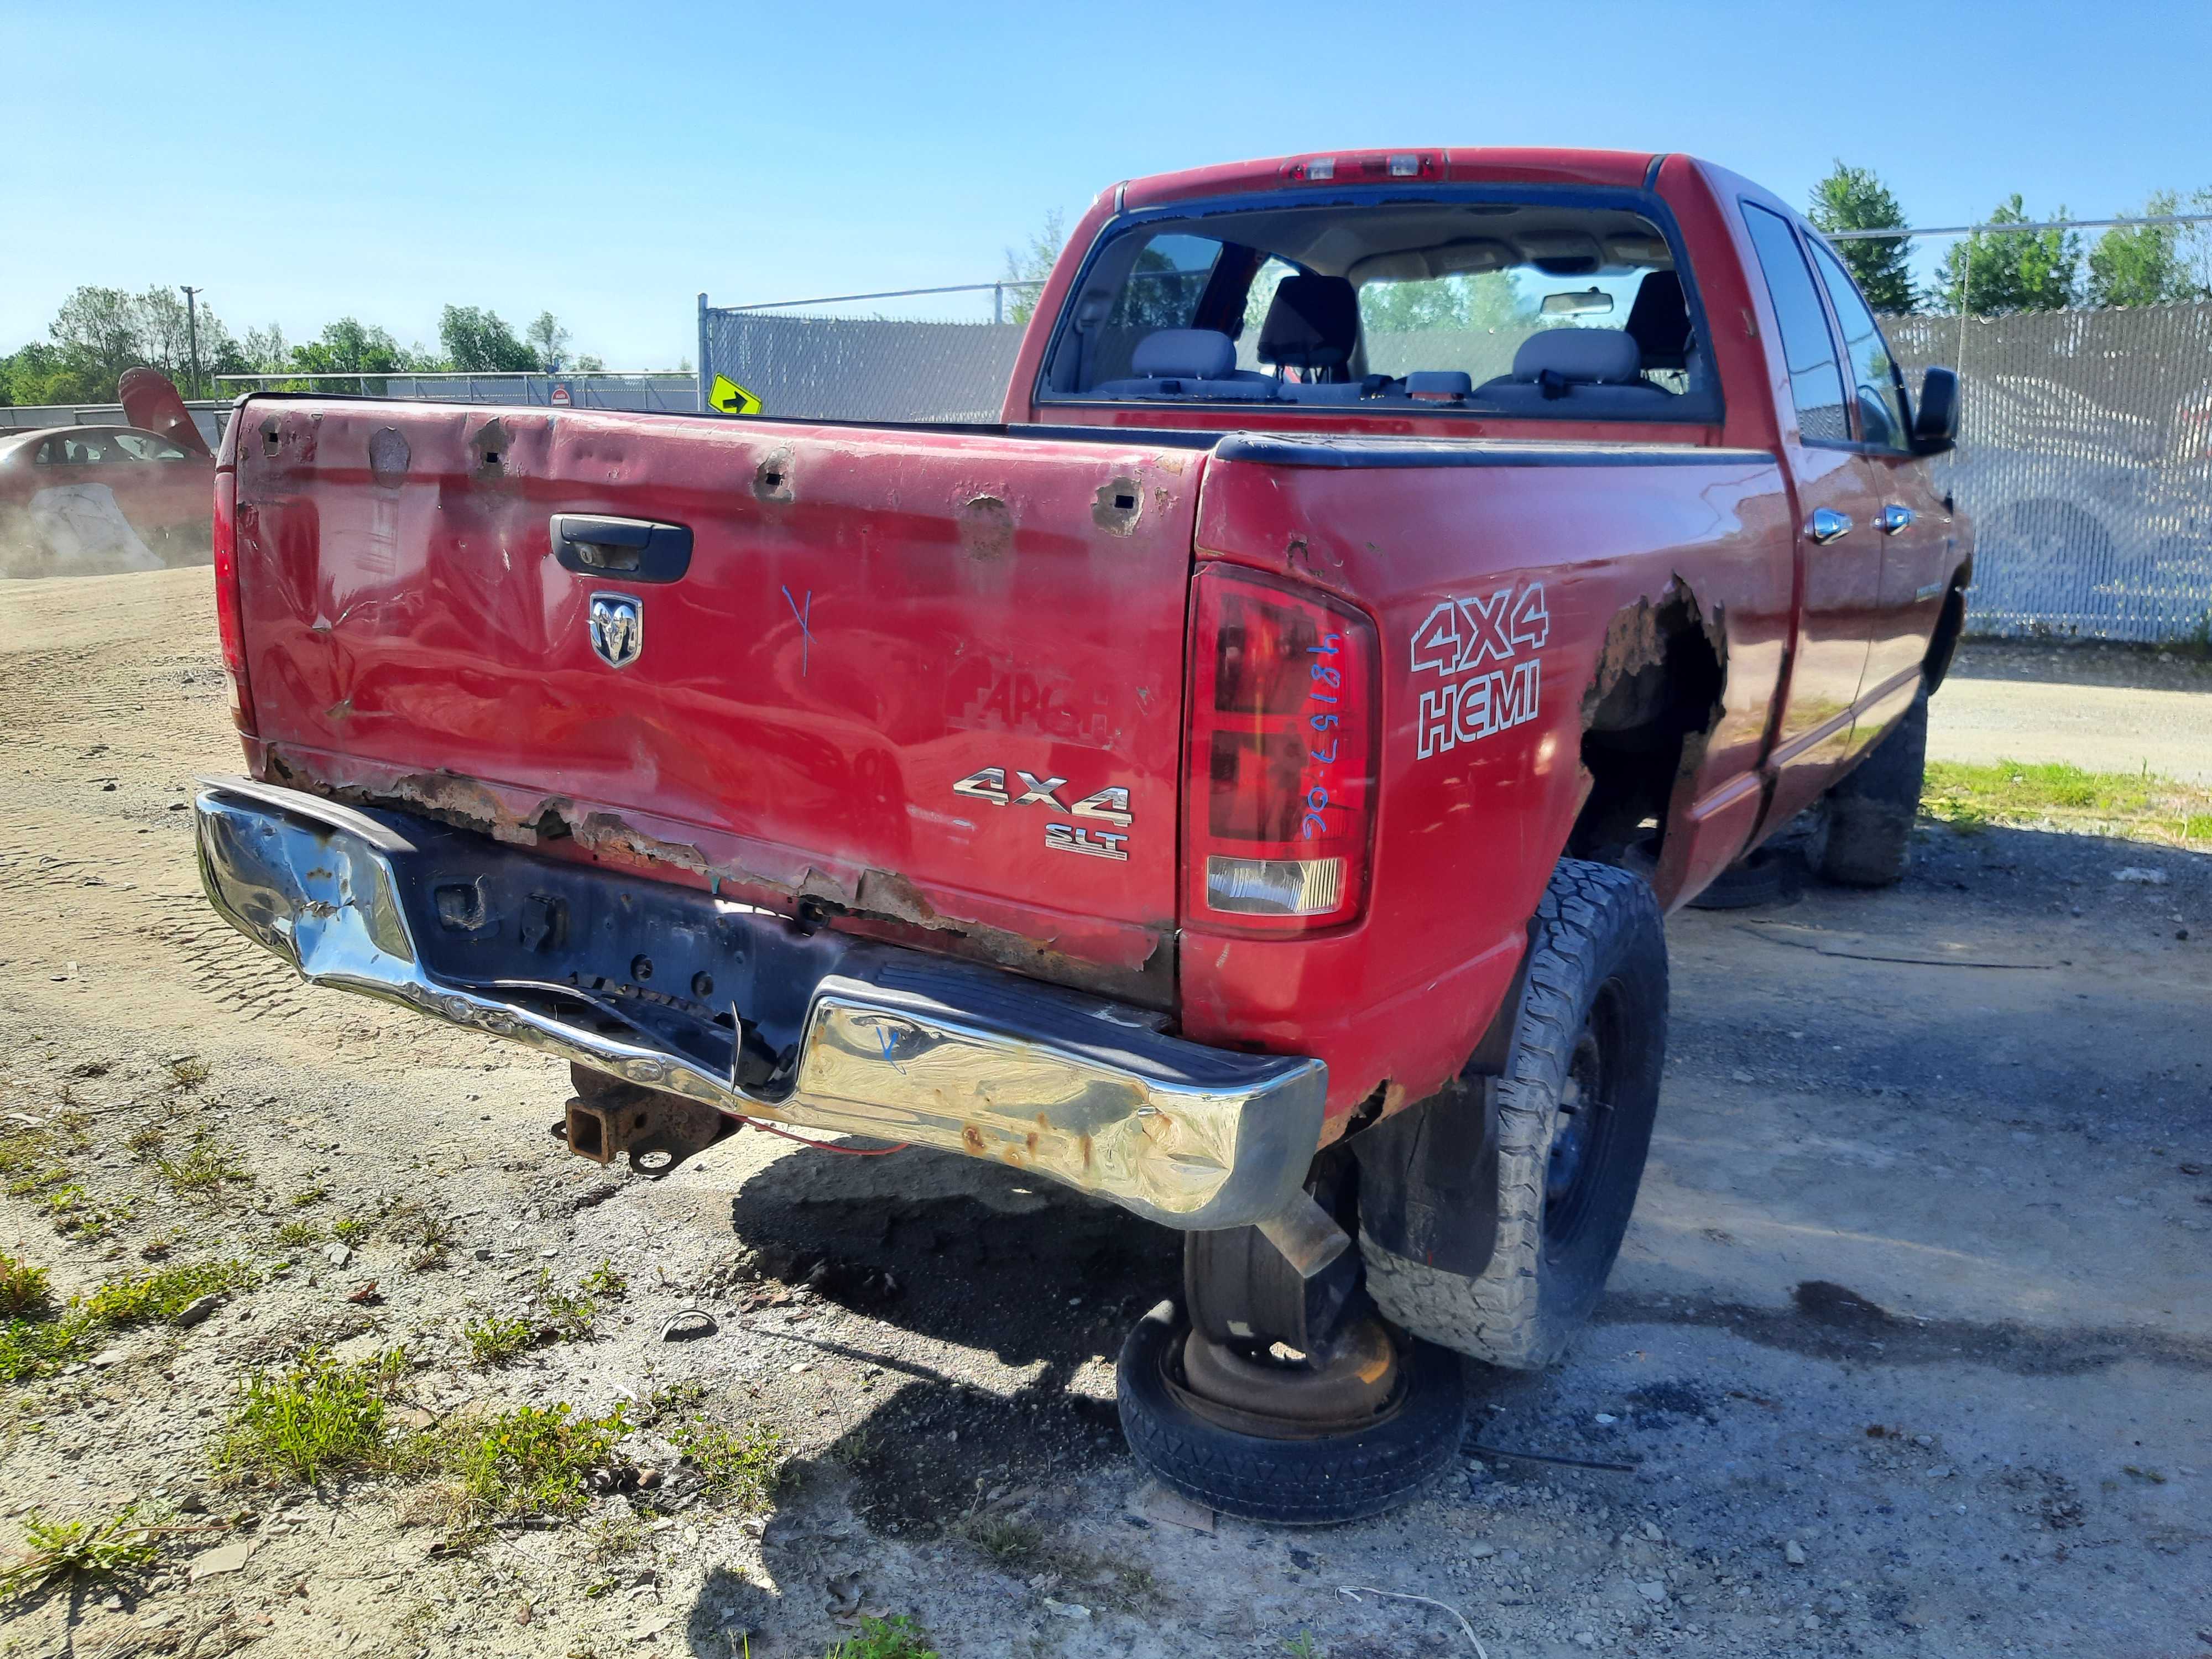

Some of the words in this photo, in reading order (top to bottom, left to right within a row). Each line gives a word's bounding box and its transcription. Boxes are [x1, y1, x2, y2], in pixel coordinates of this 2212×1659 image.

[1410, 581, 1549, 677] 4X4
[1417, 658, 1541, 761] HEMI
[952, 766, 1133, 827] 4X4
[1045, 823, 1129, 852] SLT
